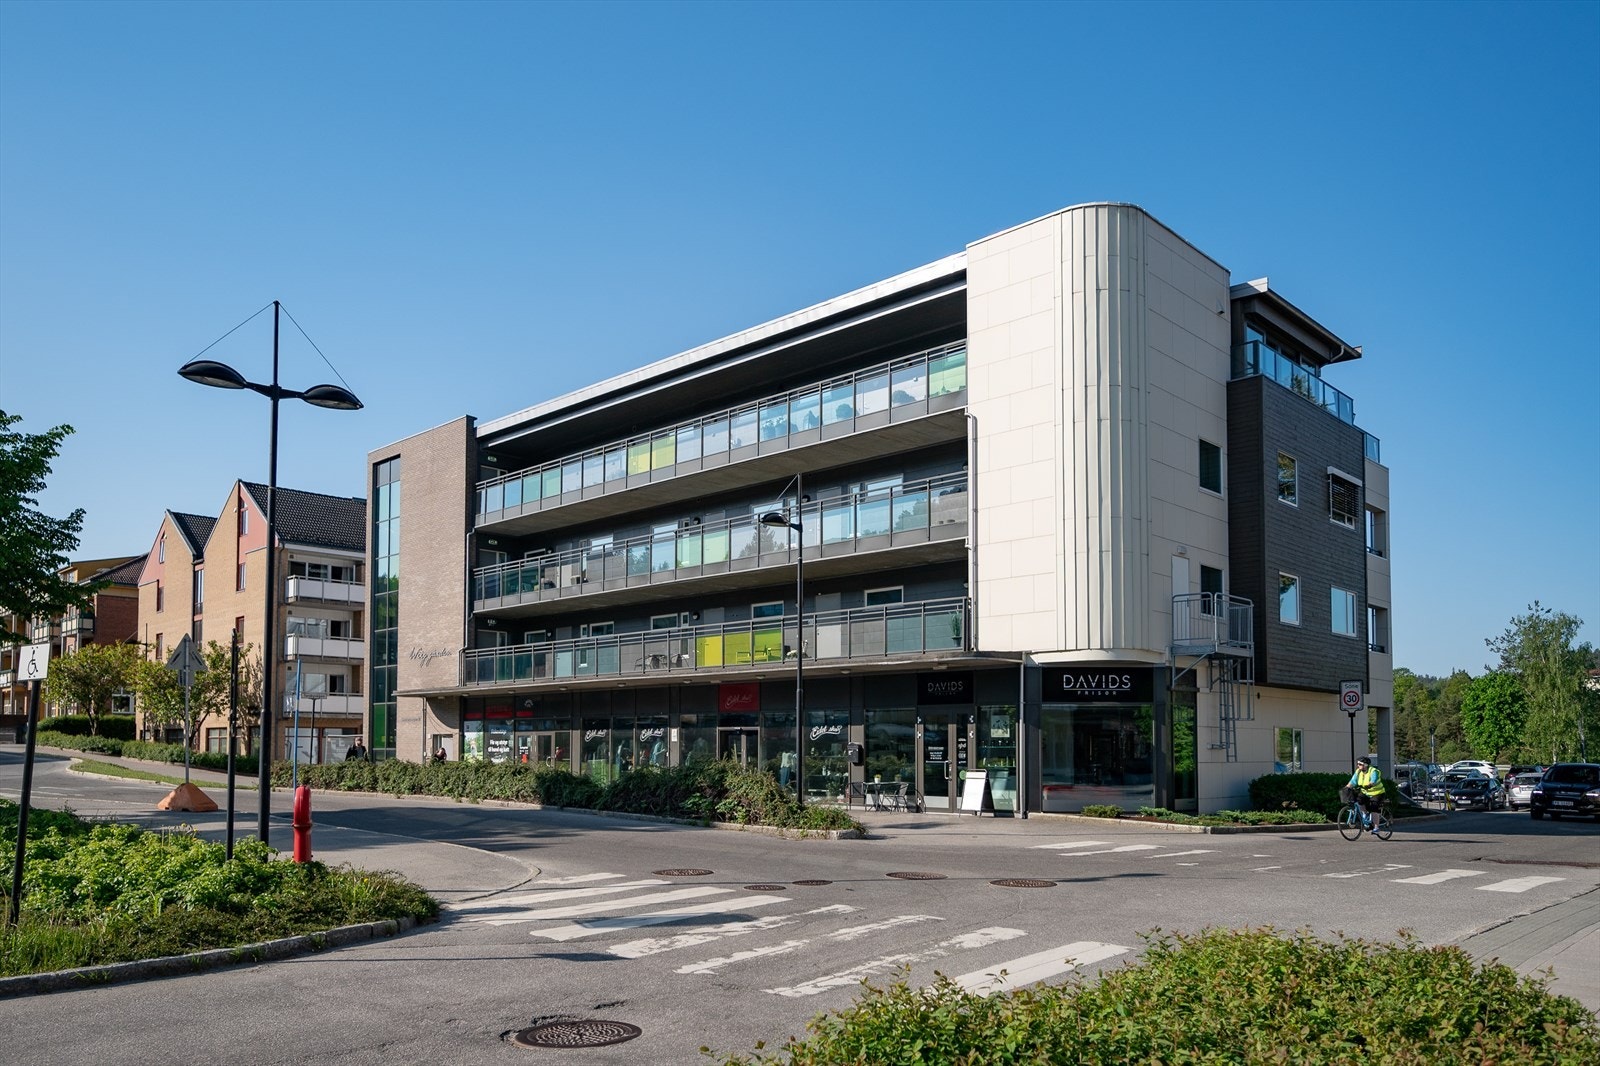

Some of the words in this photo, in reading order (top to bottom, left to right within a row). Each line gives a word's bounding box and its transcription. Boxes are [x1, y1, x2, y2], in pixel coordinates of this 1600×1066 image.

[927, 681, 964, 692] DAVIDS
[1063, 674, 1131, 689] DAVIDS
[1346, 694, 1357, 703] 30
